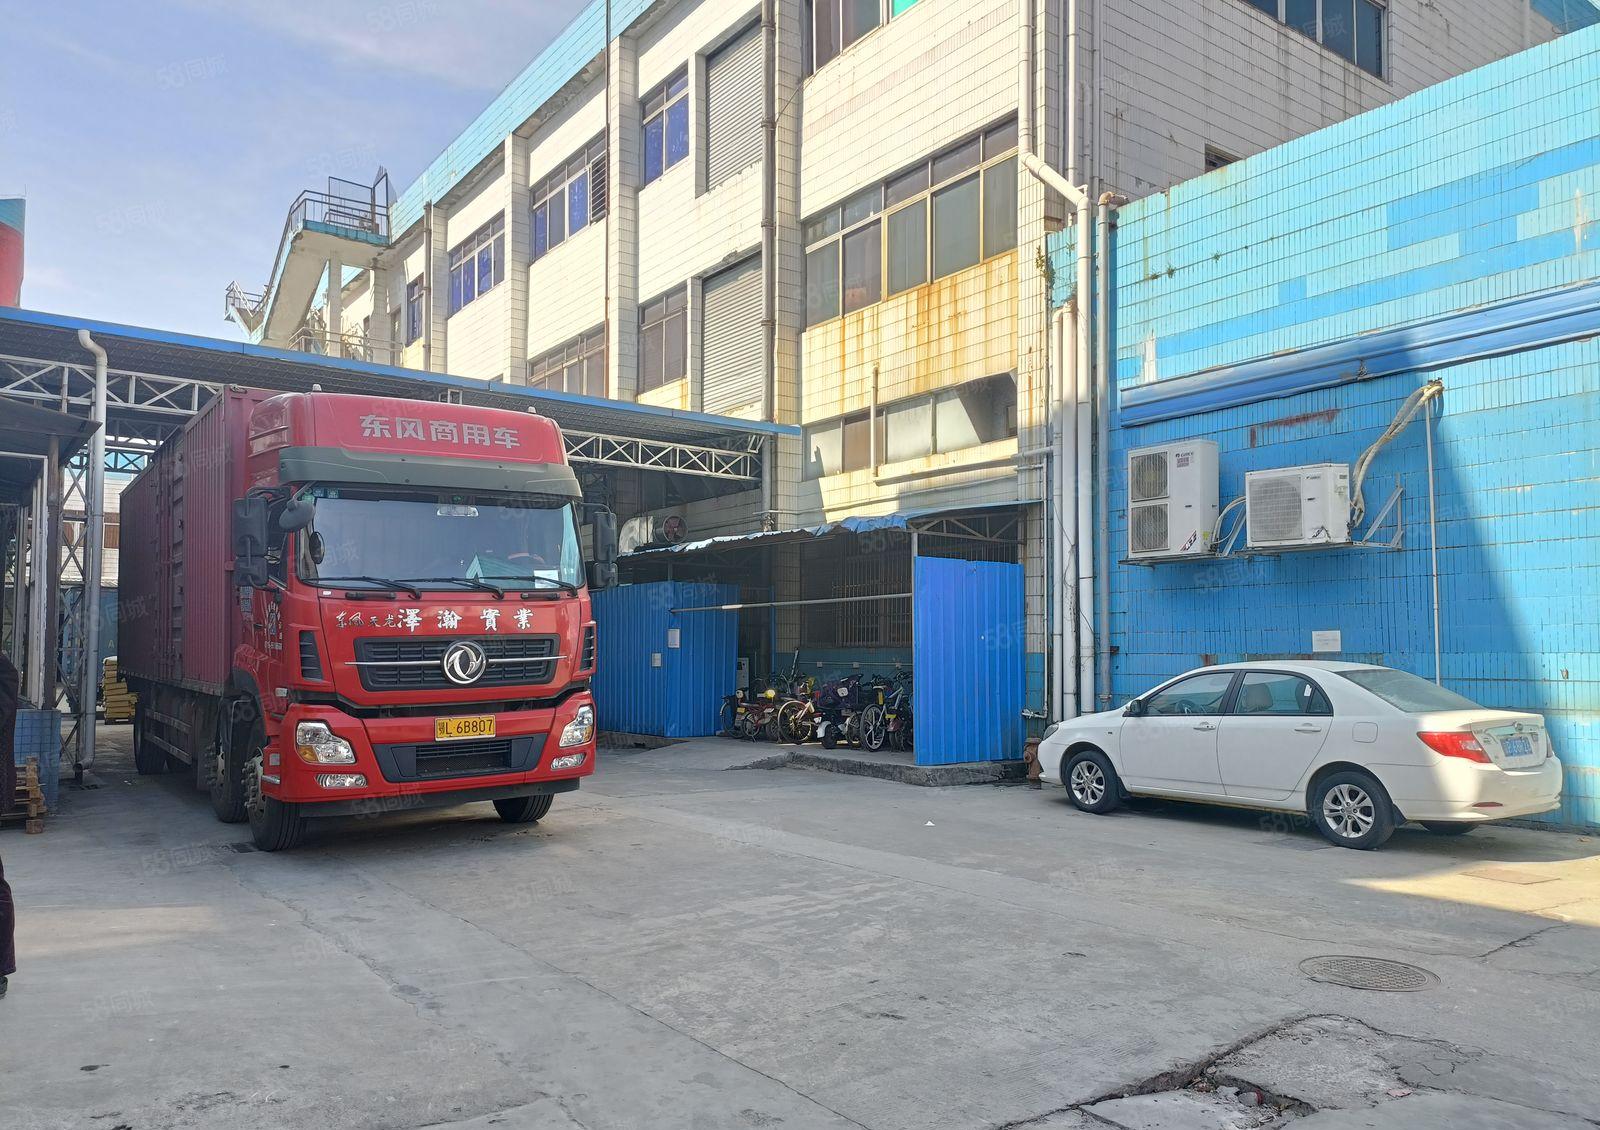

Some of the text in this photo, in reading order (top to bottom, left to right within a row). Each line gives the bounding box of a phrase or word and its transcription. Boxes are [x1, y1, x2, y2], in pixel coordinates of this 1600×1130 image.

[359, 414, 521, 449] 东风商用车
